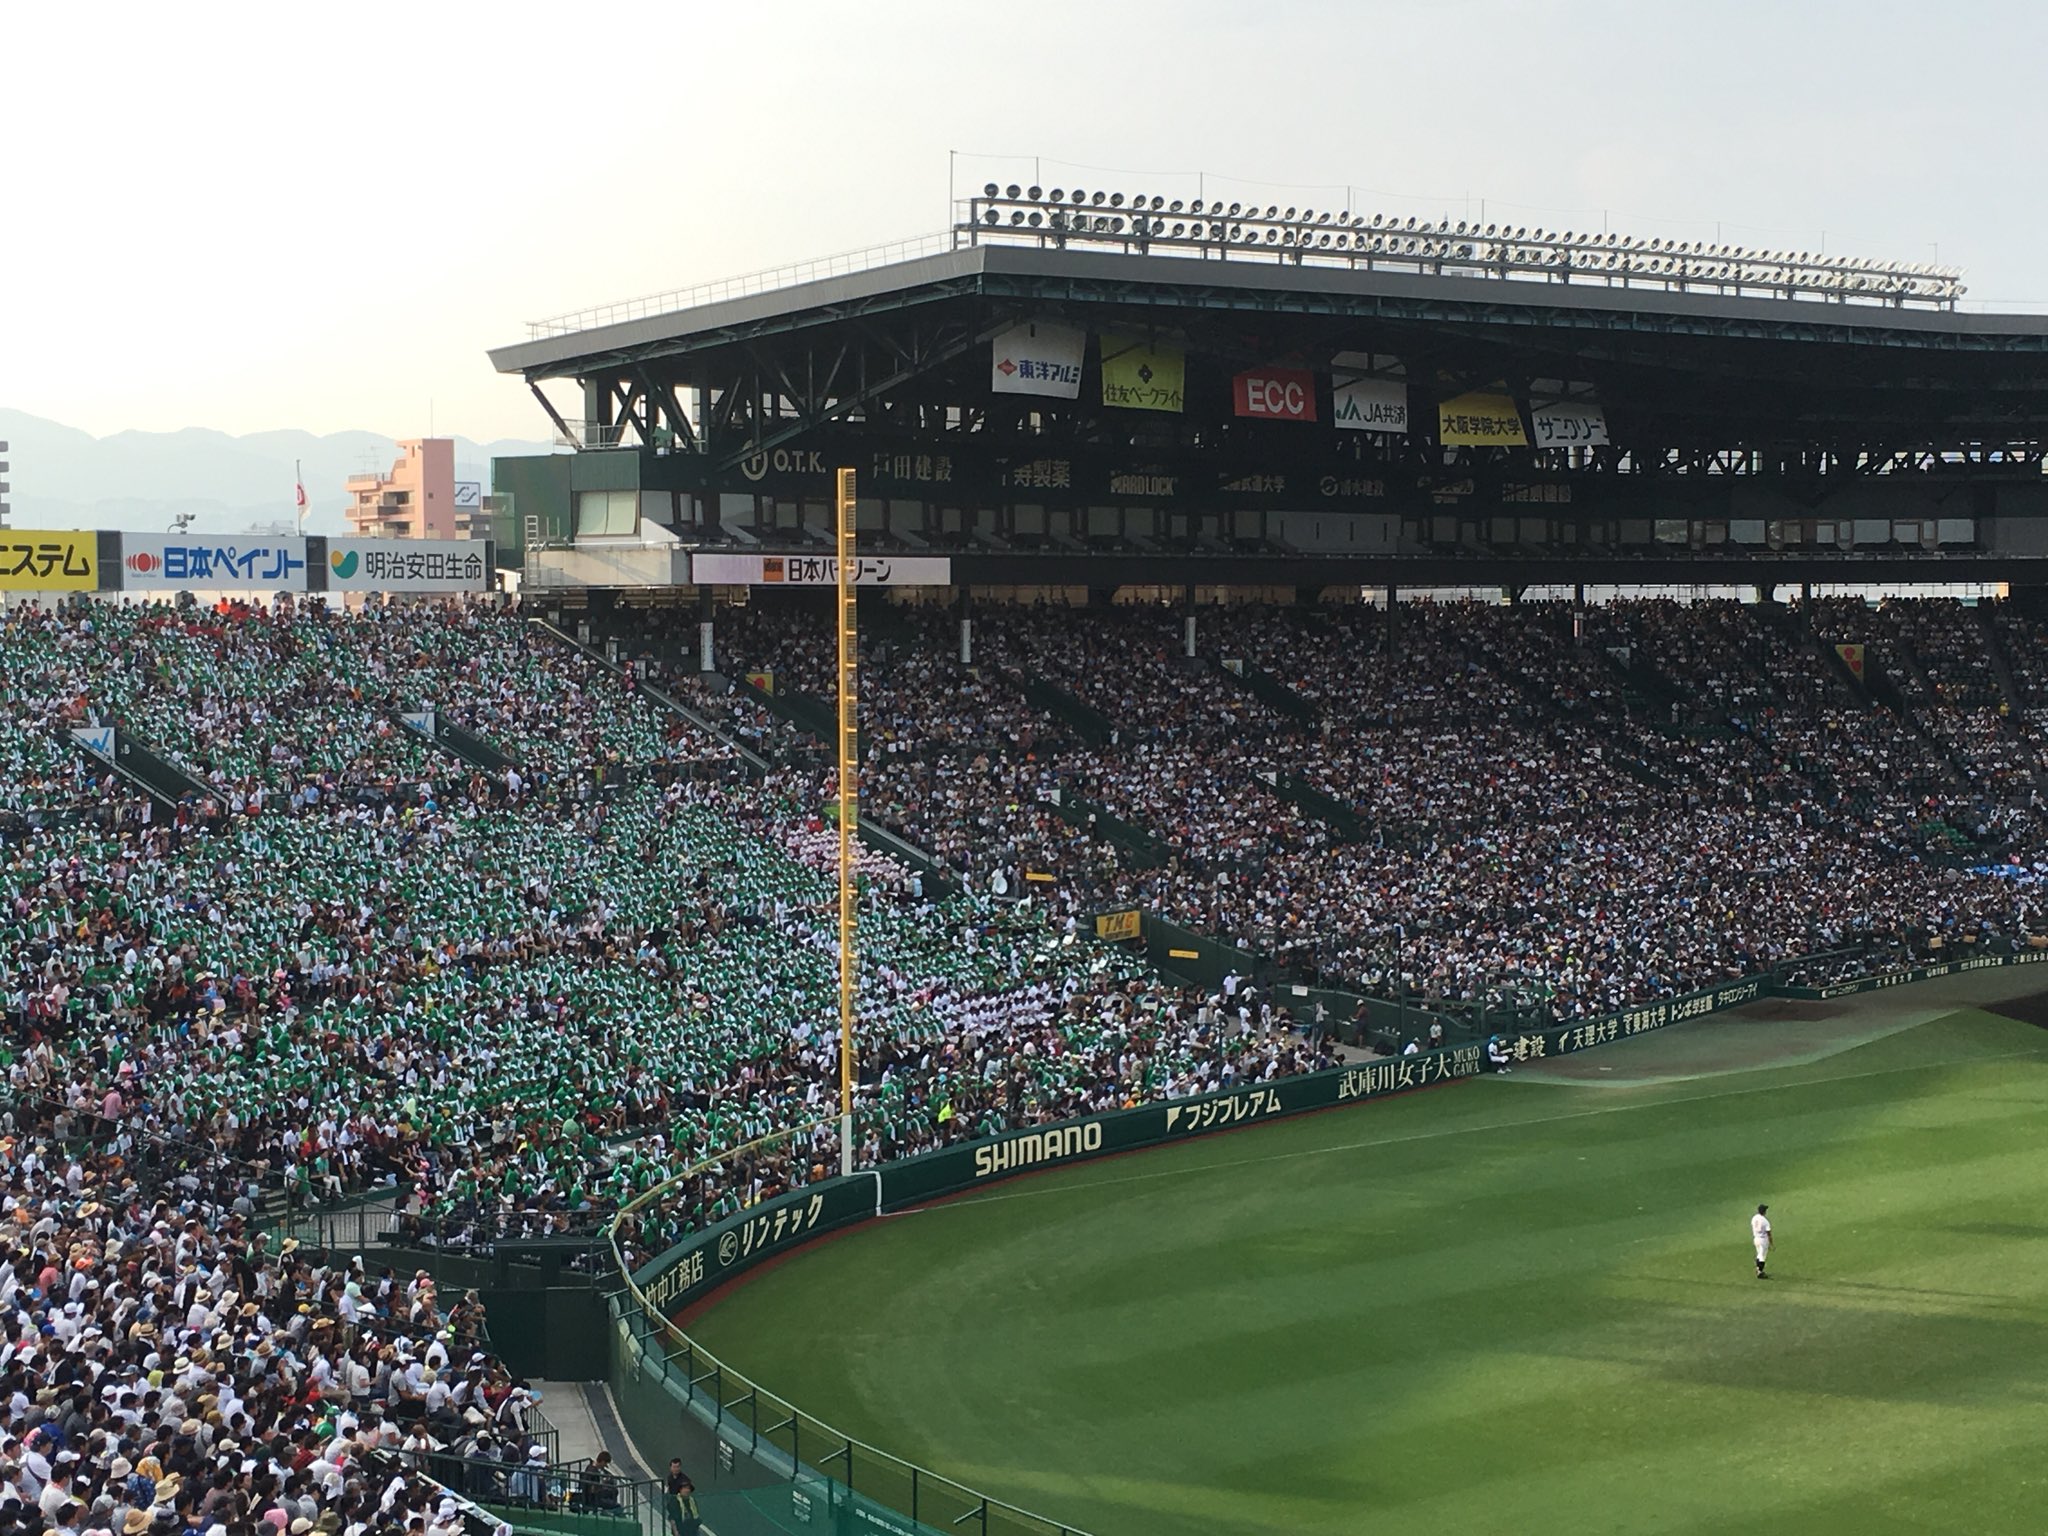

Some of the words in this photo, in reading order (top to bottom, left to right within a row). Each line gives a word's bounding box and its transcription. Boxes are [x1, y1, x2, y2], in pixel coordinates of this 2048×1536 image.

[1103, 383, 1183, 405] 住友ベークライト
[1247, 378, 1304, 415] ECC
[1442, 414, 1521, 437] 大阪学院大学
[164, 547, 304, 579] 日本ペイント
[365, 552, 482, 580] 明治安田生命
[788, 558, 891, 582] 日本バリーン
[1573, 1018, 1618, 1050] 天理大学
[1338, 1053, 1451, 1099] 武庫川女子大
[975, 1122, 1101, 1177] SHIMANO
[743, 1194, 824, 1257] リンテック
[645, 1250, 704, 1312] 竹中工務店
